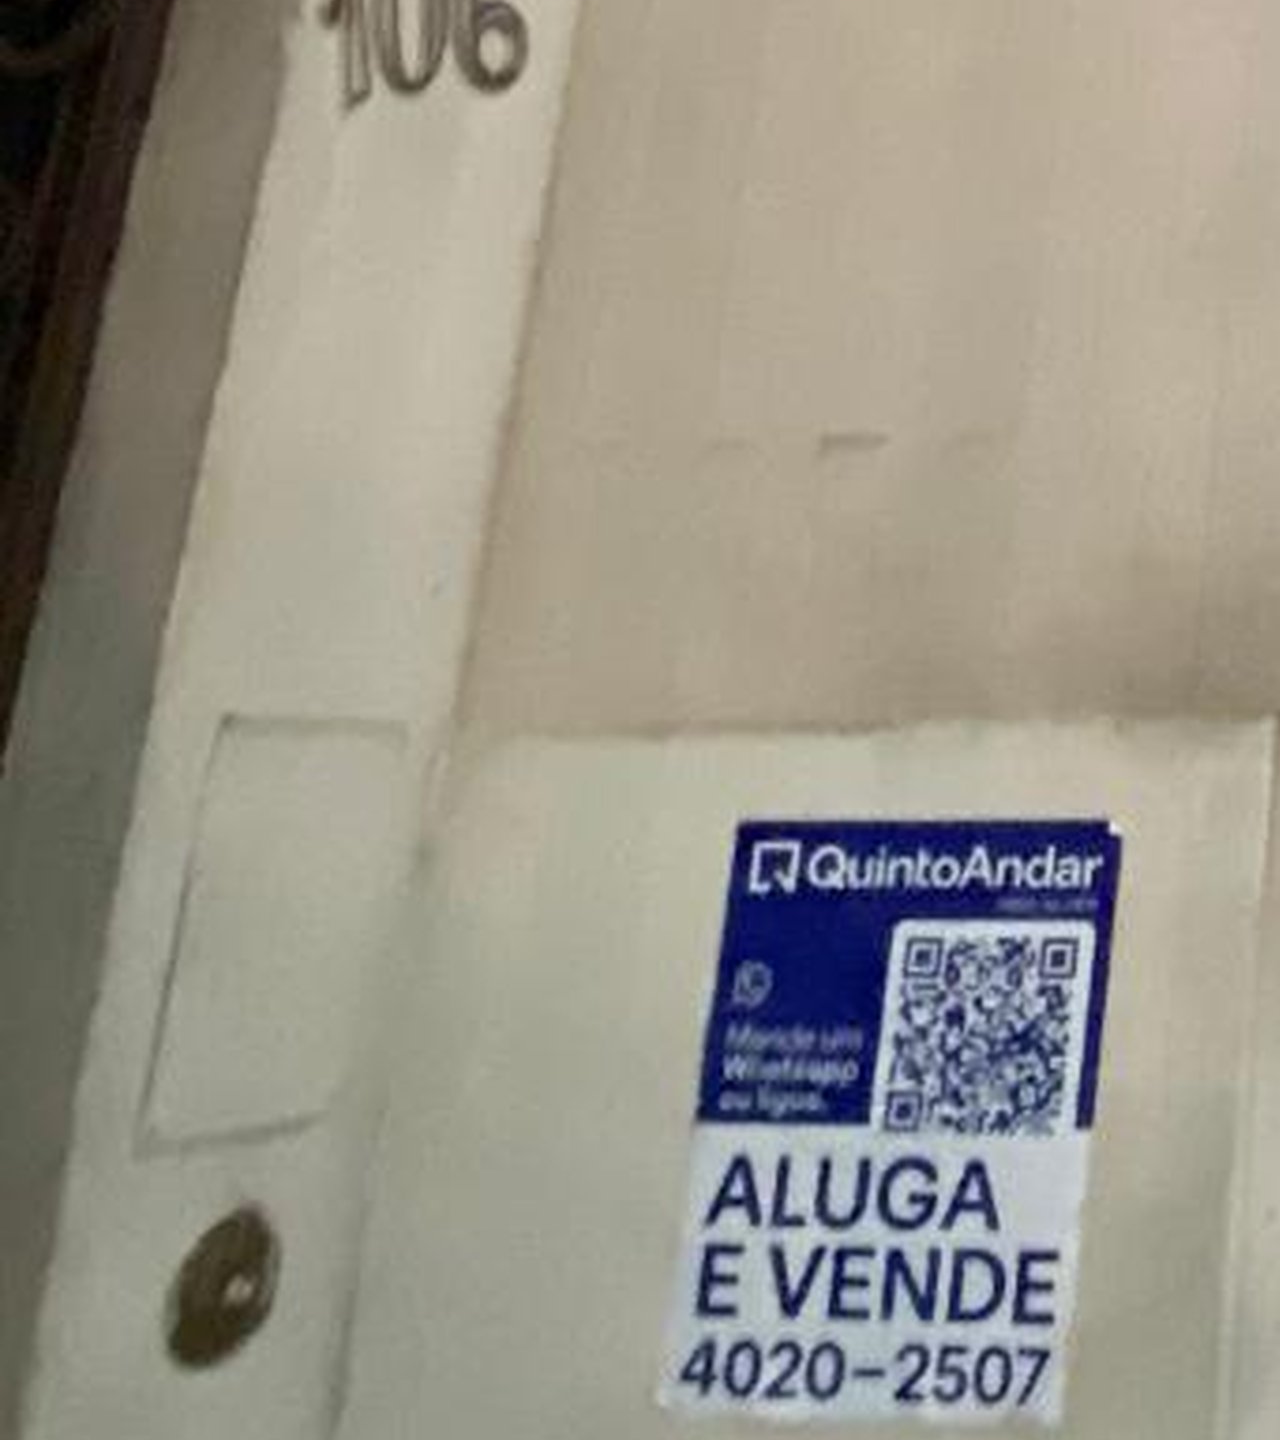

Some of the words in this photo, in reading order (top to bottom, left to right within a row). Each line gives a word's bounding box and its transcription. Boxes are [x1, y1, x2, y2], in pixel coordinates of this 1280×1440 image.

[806, 845, 1104, 890] QuintoAndar
[704, 1153, 1000, 1231] ALUGA
[696, 1243, 744, 1319] E
[769, 1245, 1060, 1326] VENDE
[679, 1337, 1051, 1405] 4020-2507
